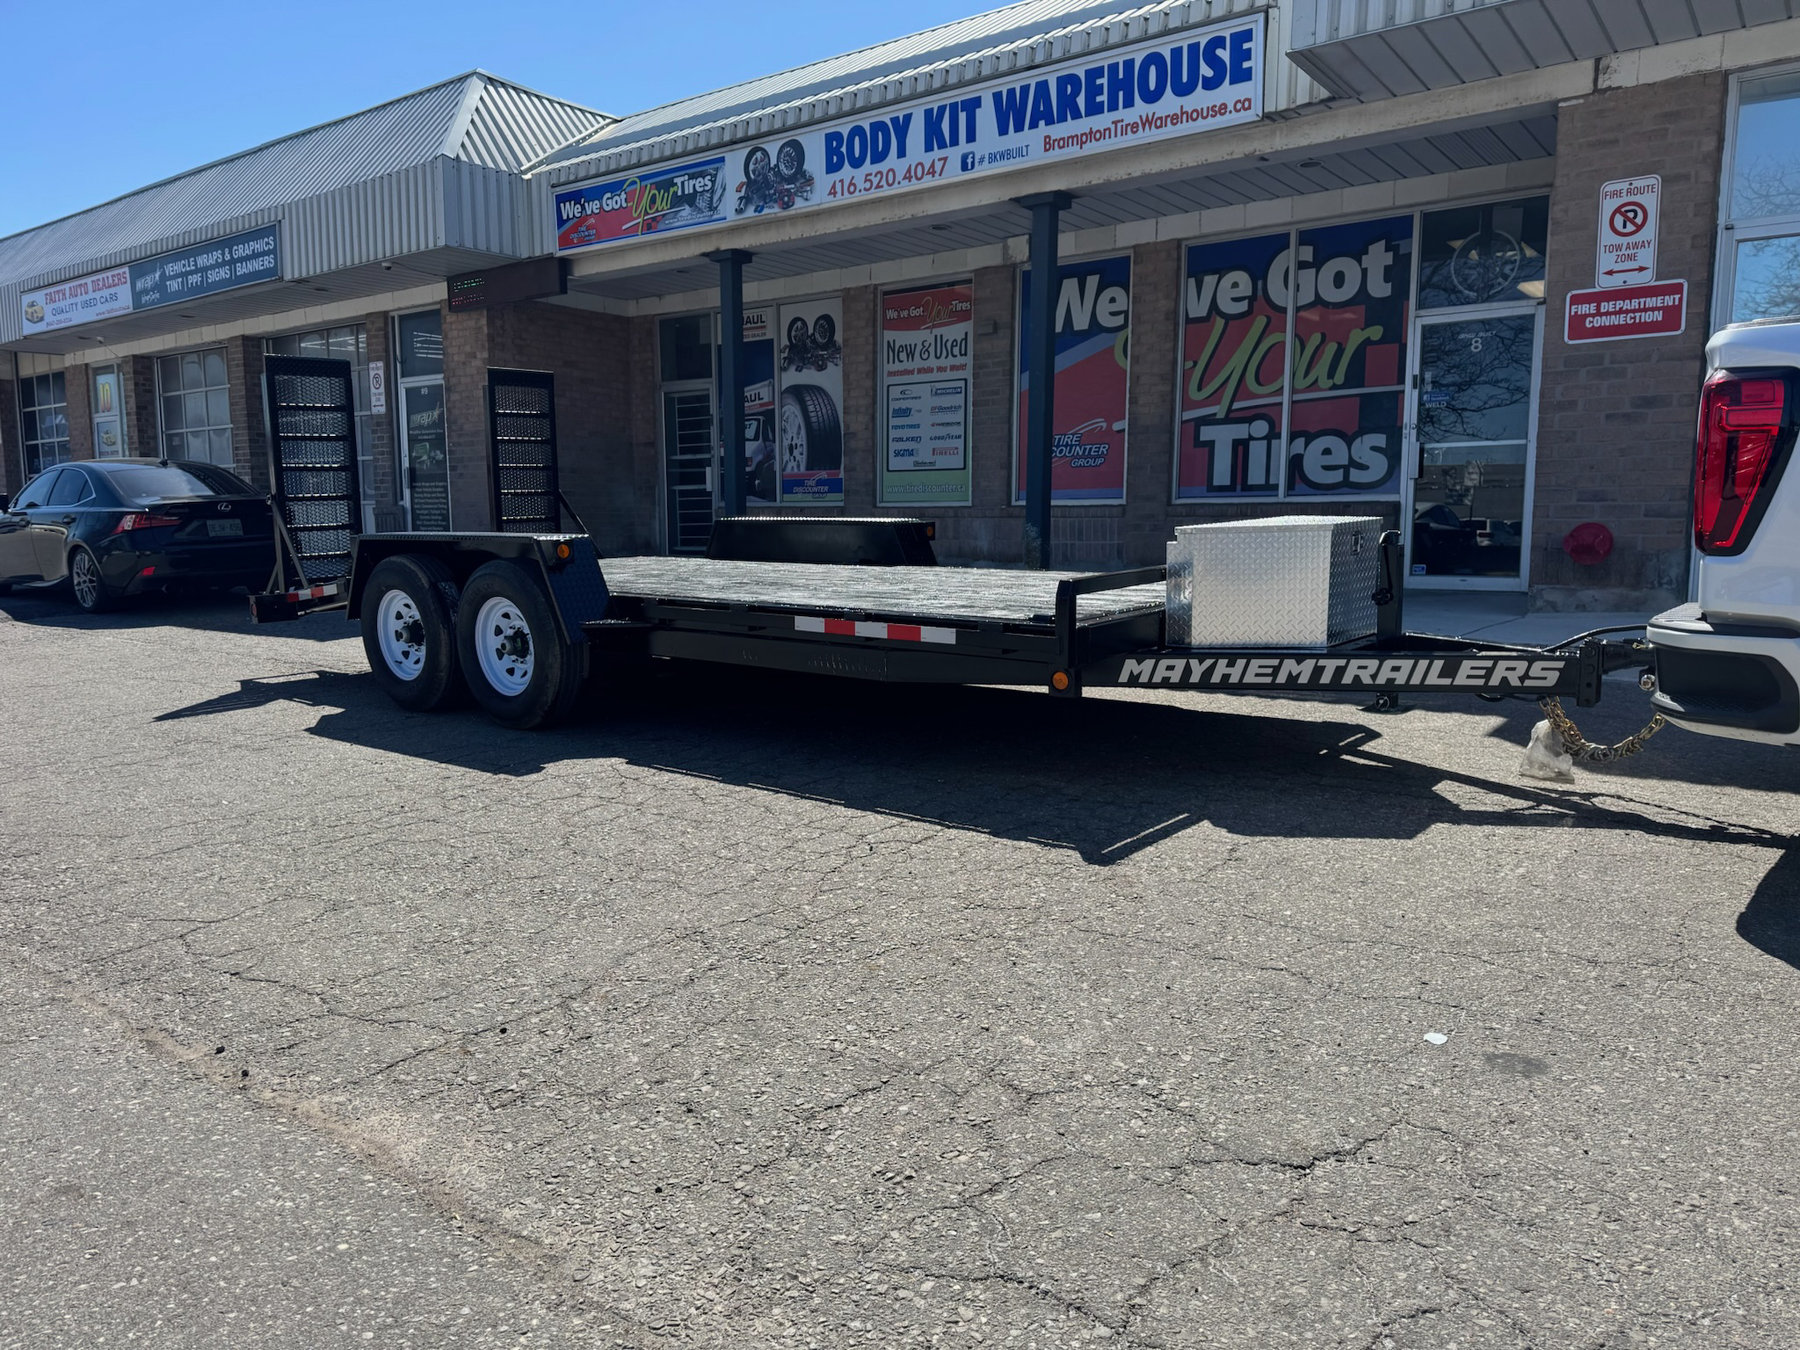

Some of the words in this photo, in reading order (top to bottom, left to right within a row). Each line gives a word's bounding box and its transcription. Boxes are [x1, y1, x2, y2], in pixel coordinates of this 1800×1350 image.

[824, 112, 913, 174] BODY
[924, 96, 982, 153] KIT
[992, 28, 1254, 136] WAREHOUSE
[1043, 98, 1252, 152] BramptonTireWarehouse.ca
[988, 144, 1029, 165] BKWBUILT
[828, 156, 949, 198] 416.520.4047
[1604, 187, 1624, 200] FIRE
[1626, 183, 1656, 197] ROUTE
[560, 198, 600, 220] We've
[602, 190, 627, 212] Got
[622, 177, 679, 236] Your
[674, 175, 713, 196] Tires
[164, 257, 195, 277] VEHICLE
[196, 250, 222, 268] WRAPS
[224, 247, 231, 261] &
[232, 236, 274, 258] GRAPHICS
[1603, 243, 1623, 254] TOW
[1625, 239, 1652, 251] AWAY
[1614, 252, 1638, 264] ZONE
[166, 278, 182, 293] TINT
[188, 273, 202, 288] PPF
[207, 266, 230, 283] SIGNS
[236, 254, 275, 275] BANNERS
[1267, 238, 1393, 308] Got
[44, 287, 67, 305] FAITH
[68, 282, 88, 298] AUTO
[92, 270, 128, 292] DEALERS
[51, 301, 78, 316] QUALITY
[80, 297, 98, 309] USED
[100, 292, 118, 305] CARS
[886, 308, 909, 320] We've
[910, 306, 924, 317] Got
[952, 300, 971, 312] Tires
[1570, 303, 1597, 315] FIRE
[1600, 294, 1681, 313] DEPARTMENT
[743, 313, 766, 326] AUL
[1585, 310, 1663, 328] CONNECTION
[887, 339, 917, 364] New
[919, 339, 932, 361] &
[934, 331, 968, 360] Used
[1470, 337, 1482, 353] 8
[1187, 314, 1384, 419] Your
[744, 391, 764, 404] AUL
[1054, 434, 1082, 446] TIRE
[1071, 457, 1105, 467] GROUP
[1200, 418, 1389, 487] Tires
[1118, 658, 1565, 687] MAYHEMTRAILERS
